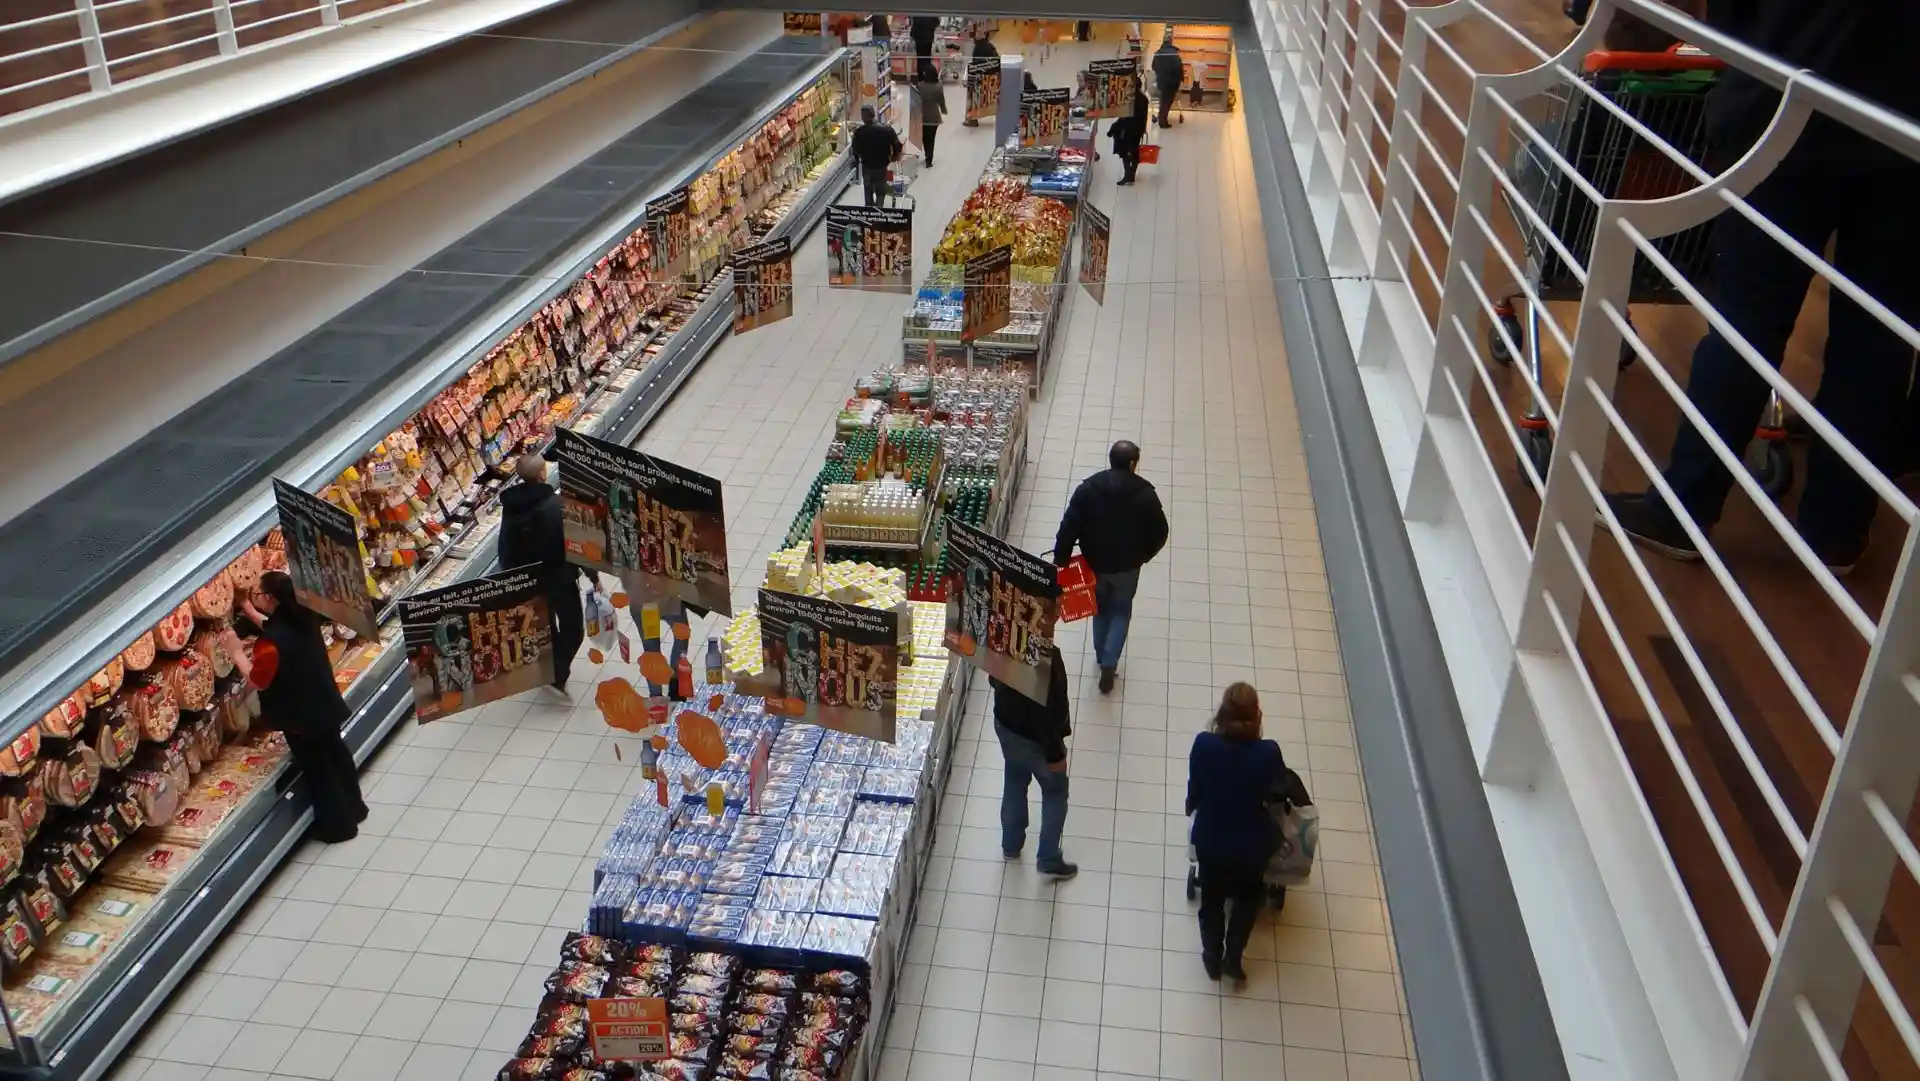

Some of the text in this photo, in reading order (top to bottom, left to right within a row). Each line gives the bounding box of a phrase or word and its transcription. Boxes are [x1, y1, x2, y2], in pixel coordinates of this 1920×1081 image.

[565, 439, 584, 452] Mais
[628, 461, 645, 471] sont
[682, 479, 713, 496] environ
[594, 460, 623, 475] articles
[608, 476, 694, 551] CHEZ
[607, 517, 699, 585] NOUS
[408, 606, 441, 619] environ
[472, 589, 503, 602] articles
[505, 578, 538, 593] Migros?
[475, 582, 493, 592] sont
[828, 608, 846, 616] sont
[966, 555, 1043, 631] CHEZ
[434, 605, 537, 656] CHEZ
[765, 604, 795, 615] environ
[824, 615, 855, 627] articles
[856, 619, 890, 632] Migros?
[963, 590, 1041, 667] NOUS
[435, 633, 541, 692] NOUS
[786, 620, 884, 681] CHEZ
[782, 653, 884, 711] NOUS
[606, 1002, 647, 1018] 20%
[610, 1025, 648, 1036] ACTION
